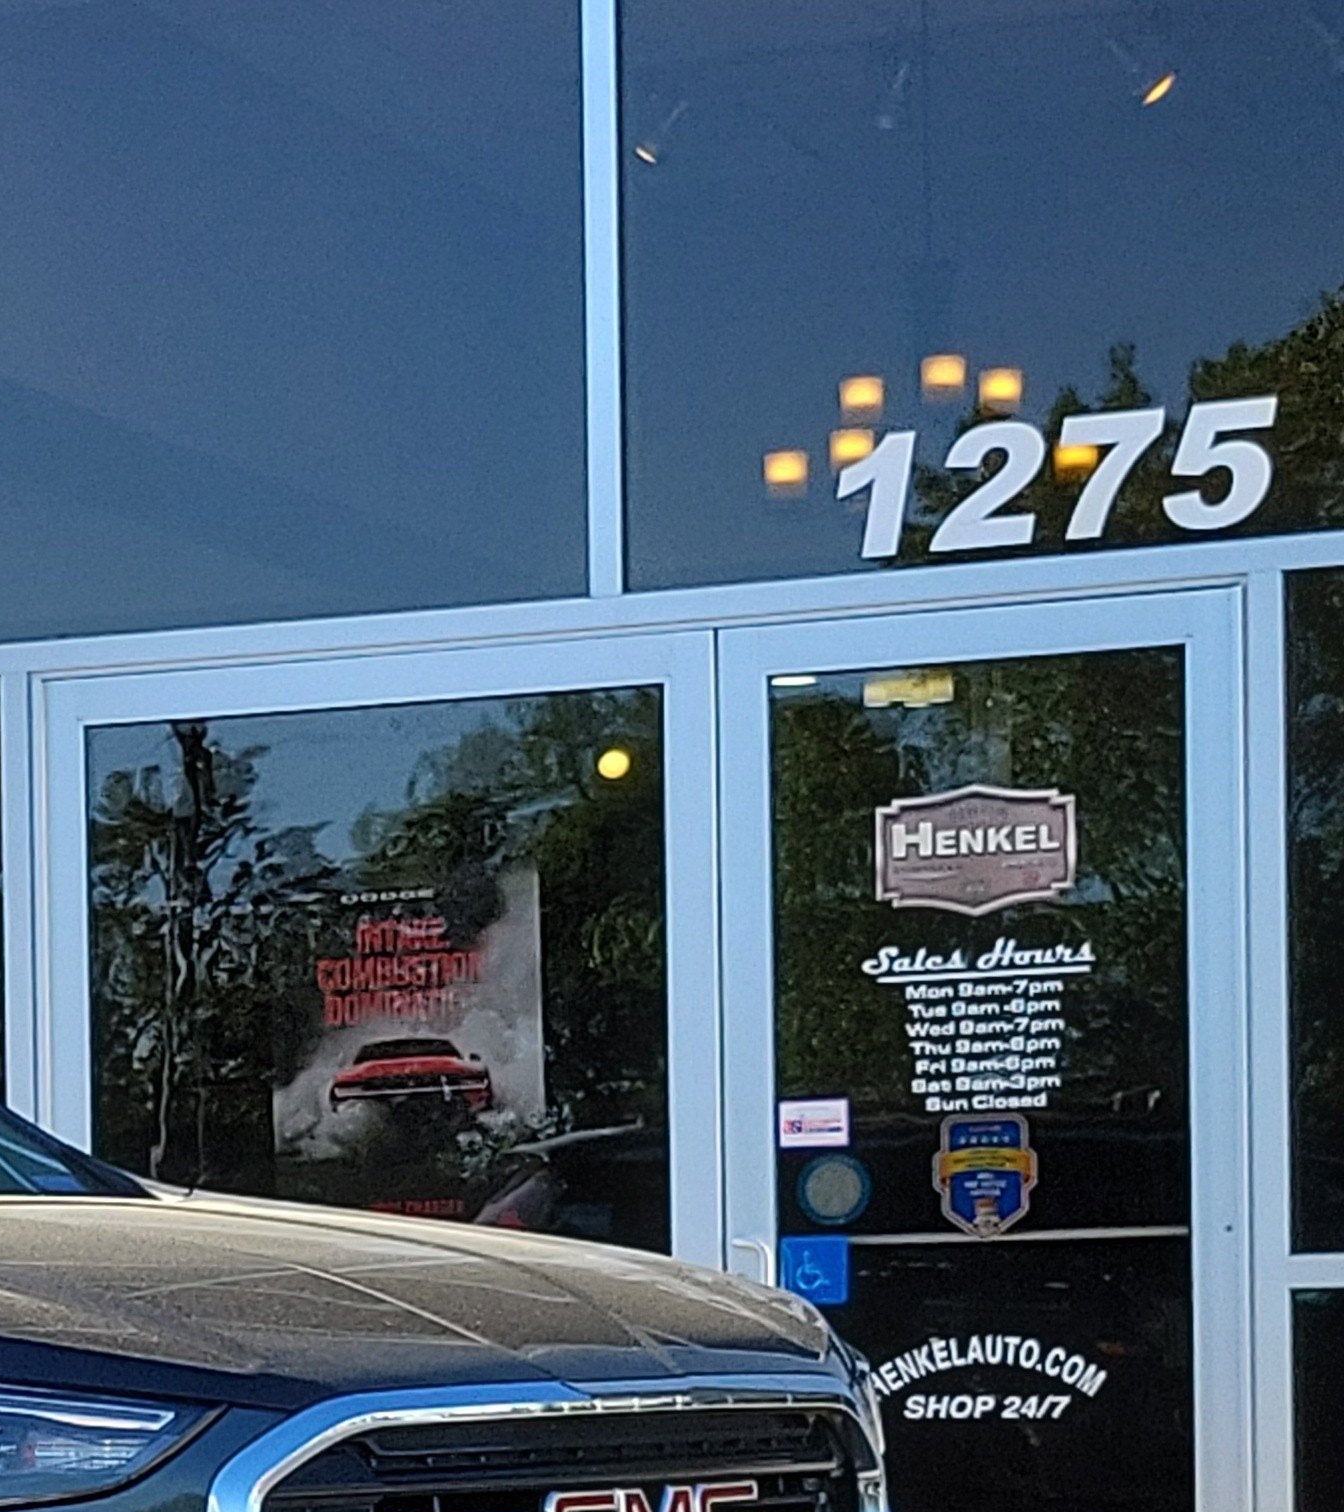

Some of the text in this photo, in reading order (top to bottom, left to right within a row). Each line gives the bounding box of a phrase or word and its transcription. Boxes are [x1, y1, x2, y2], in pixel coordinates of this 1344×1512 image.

[836, 395, 1277, 559] 1275
[891, 821, 1060, 859] HENKEL
[861, 936, 1096, 975] Sales Hours
[905, 979, 1064, 1000] Mon 9am-7pm
[907, 1003, 947, 1019] Tue
[904, 1017, 1065, 1037] Wed 9am-7pm
[908, 1040, 952, 1055] Thu
[915, 1059, 947, 1075] Fri
[911, 1078, 952, 1093] Sat
[925, 1092, 1048, 1112] Sun Closed
[903, 1395, 1072, 1420] SHOP 24/7
